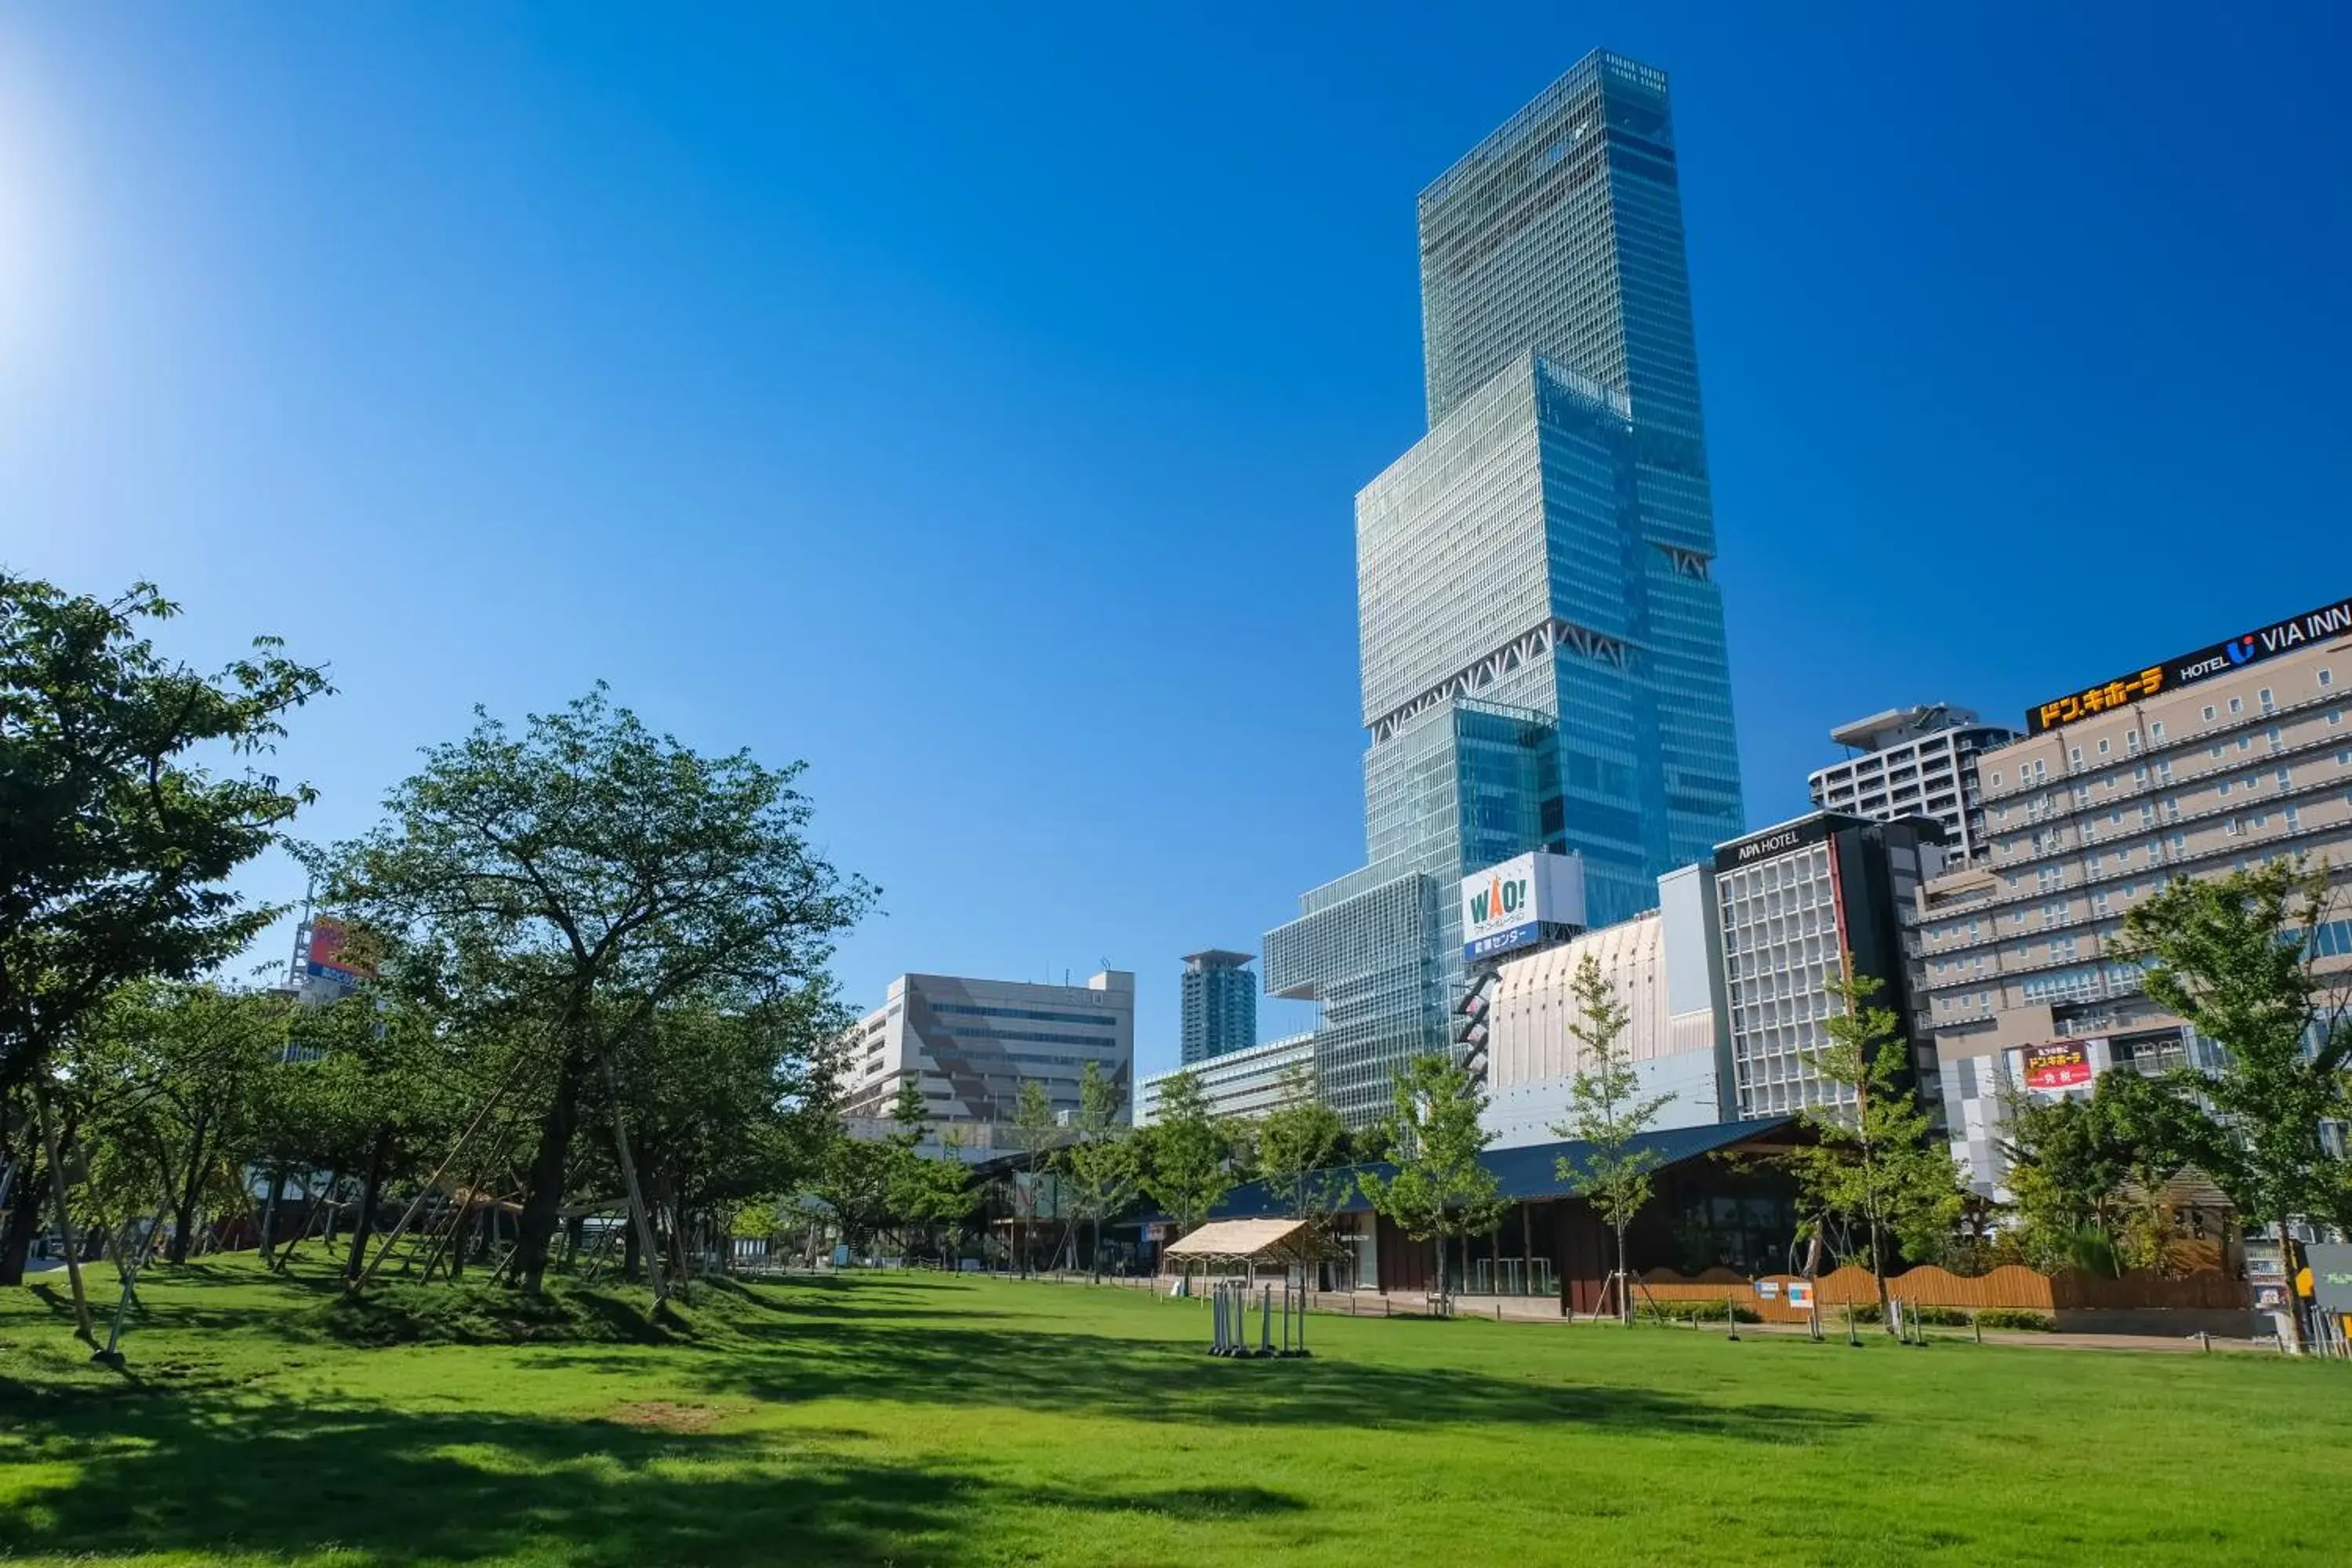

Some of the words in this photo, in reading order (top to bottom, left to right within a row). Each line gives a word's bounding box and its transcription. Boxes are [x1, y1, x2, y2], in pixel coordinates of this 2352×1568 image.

[2181, 656, 2230, 680] HOTEL
[2261, 623, 2305, 652] VIA
[2307, 604, 2352, 637] INN
[1739, 843, 1760, 861] APA
[1761, 831, 1799, 853] HOTEL
[1471, 876, 1526, 924] WAO!
